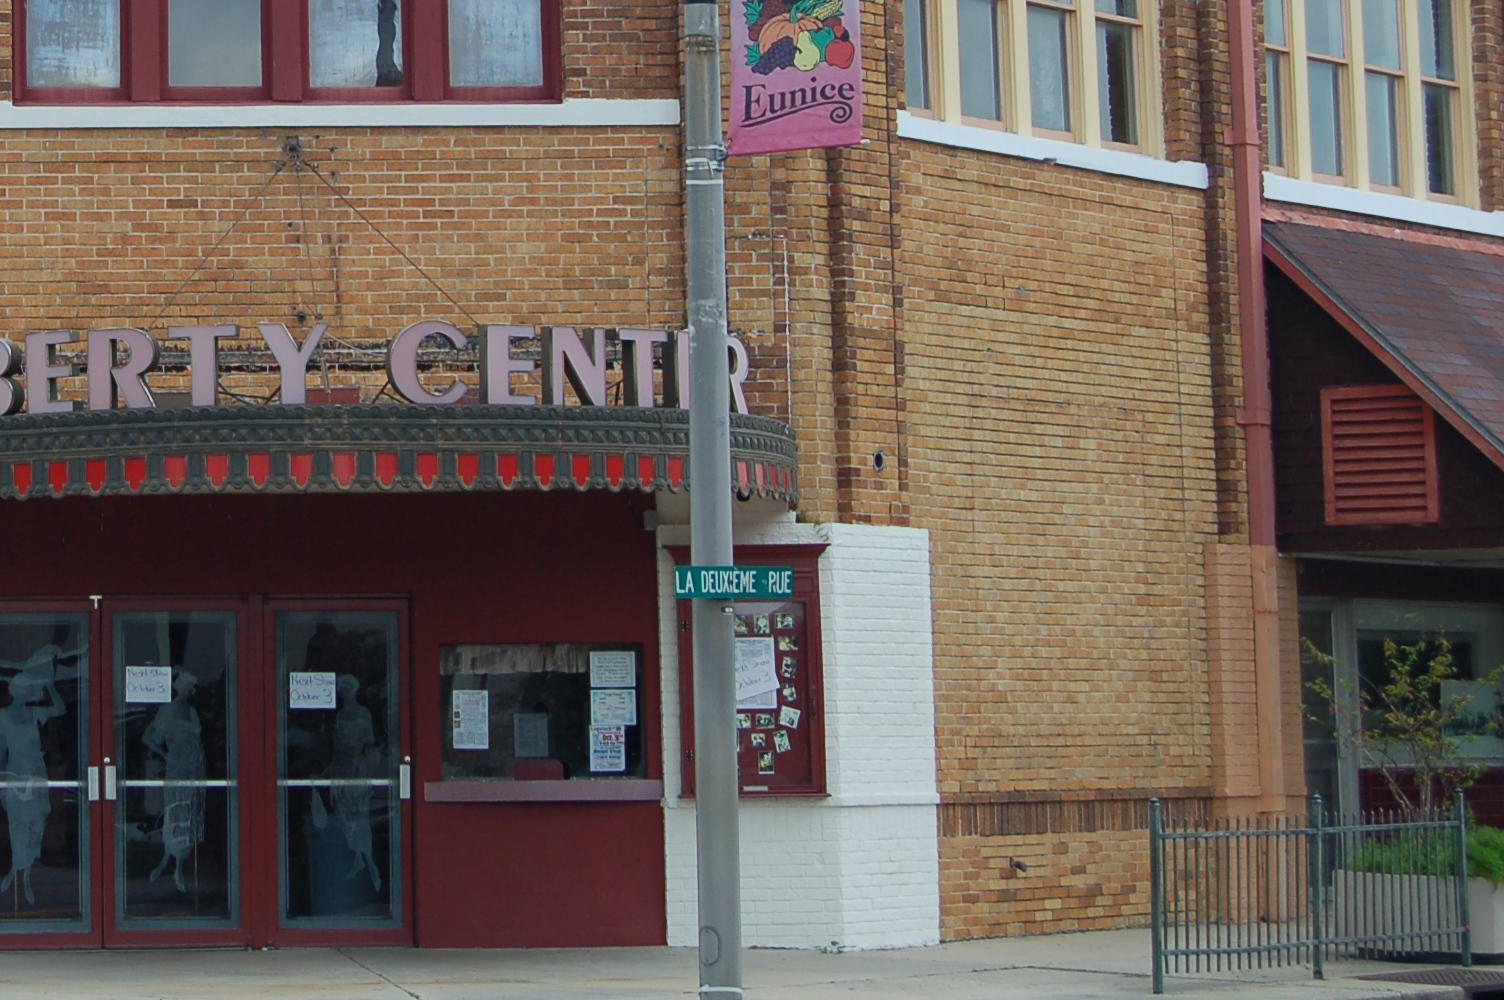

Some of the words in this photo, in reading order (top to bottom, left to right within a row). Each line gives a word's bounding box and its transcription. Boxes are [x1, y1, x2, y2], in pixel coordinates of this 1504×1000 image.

[740, 77, 855, 123] Eunice
[675, 570, 695, 594] LA
[768, 570, 792, 594] RUE
